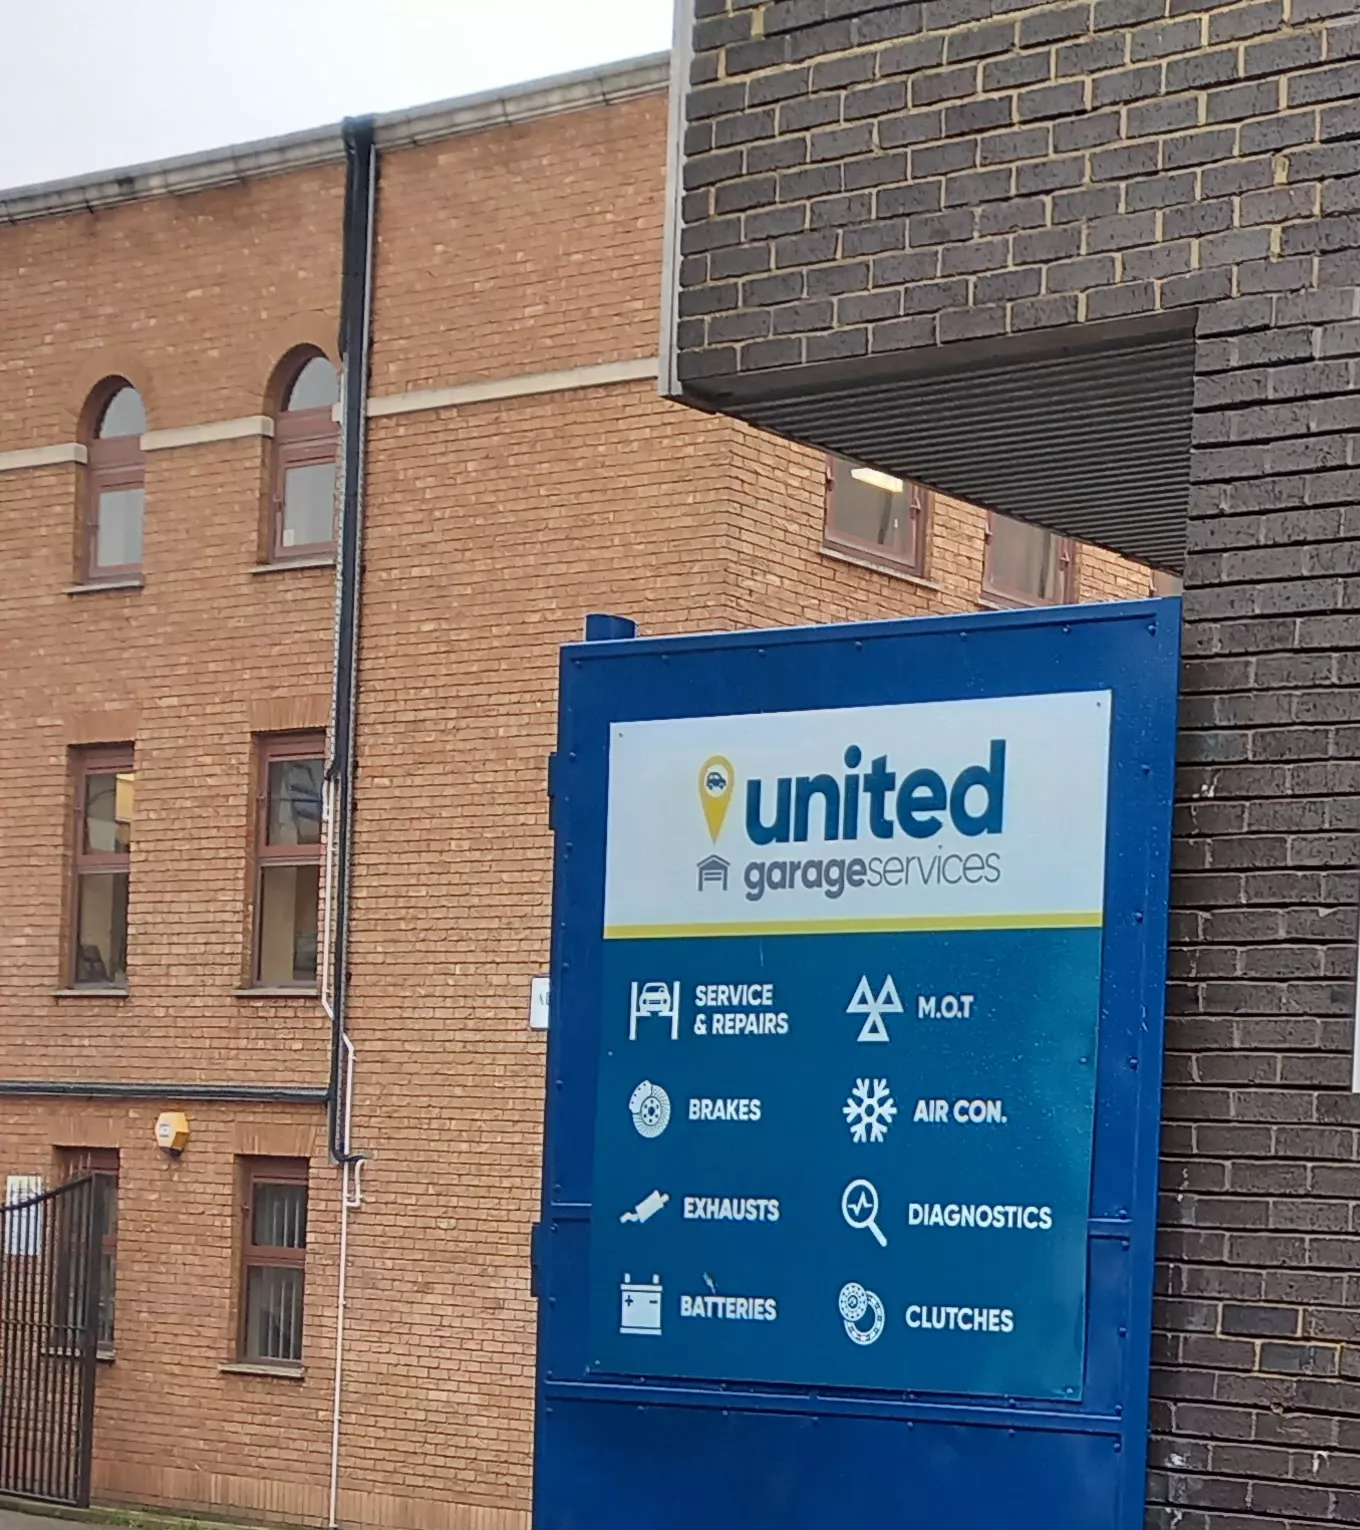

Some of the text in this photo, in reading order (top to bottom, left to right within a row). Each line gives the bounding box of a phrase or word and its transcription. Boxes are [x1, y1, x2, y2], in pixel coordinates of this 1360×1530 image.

[745, 738, 1007, 846] united
[695, 984, 774, 1006] SERVICE
[918, 995, 974, 1019] M.O.T
[694, 1012, 789, 1035] & REPAIRS
[688, 1098, 761, 1121] BRAKES
[913, 1099, 1008, 1123] AIR CON.
[683, 1196, 780, 1221] EXHAUSTS
[908, 1203, 1053, 1231] DIAGNOSTICS
[680, 1295, 777, 1321] BATTERIES
[905, 1304, 1014, 1333] CLUTCHES
